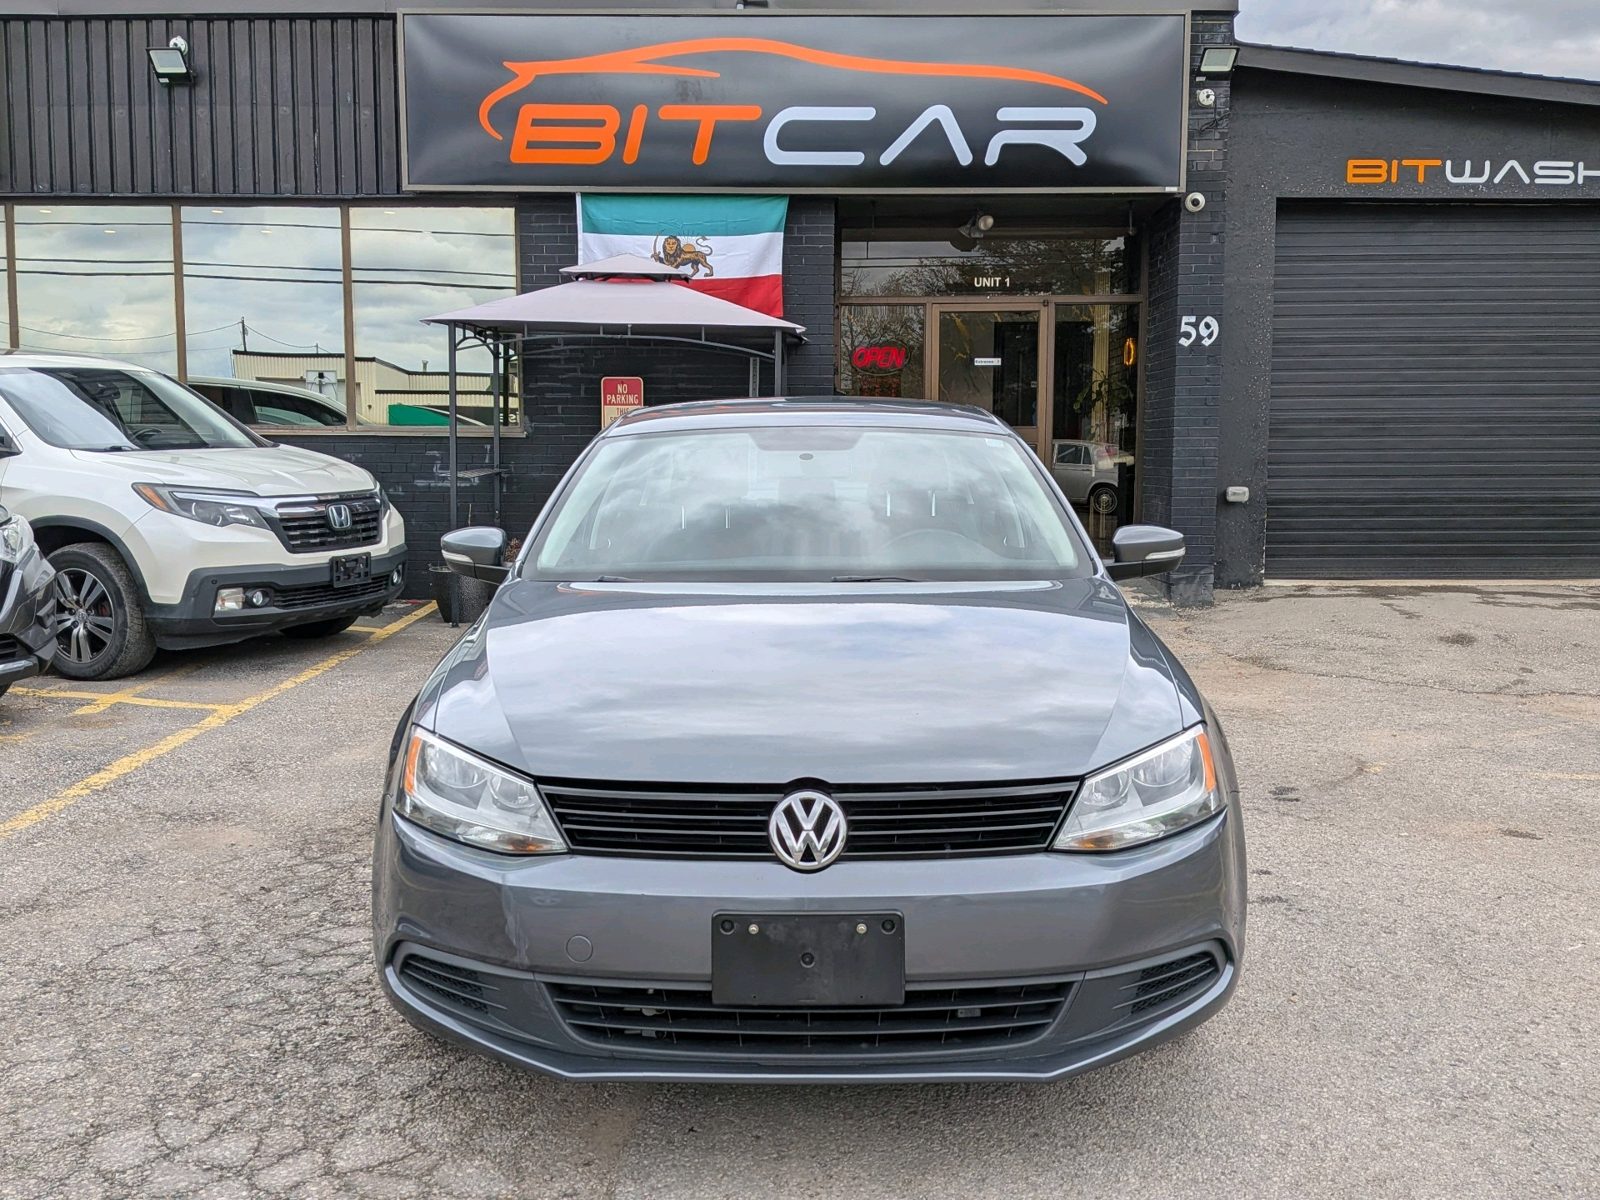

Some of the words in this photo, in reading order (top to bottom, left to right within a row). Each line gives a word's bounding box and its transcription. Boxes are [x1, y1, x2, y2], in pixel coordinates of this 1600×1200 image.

[974, 276, 1002, 288] UNIT
[1004, 276, 1010, 288] 1
[1178, 315, 1220, 347] 59
[852, 345, 906, 369] OPEN
[617, 383, 628, 394] NO
[606, 394, 639, 404] PARKING
